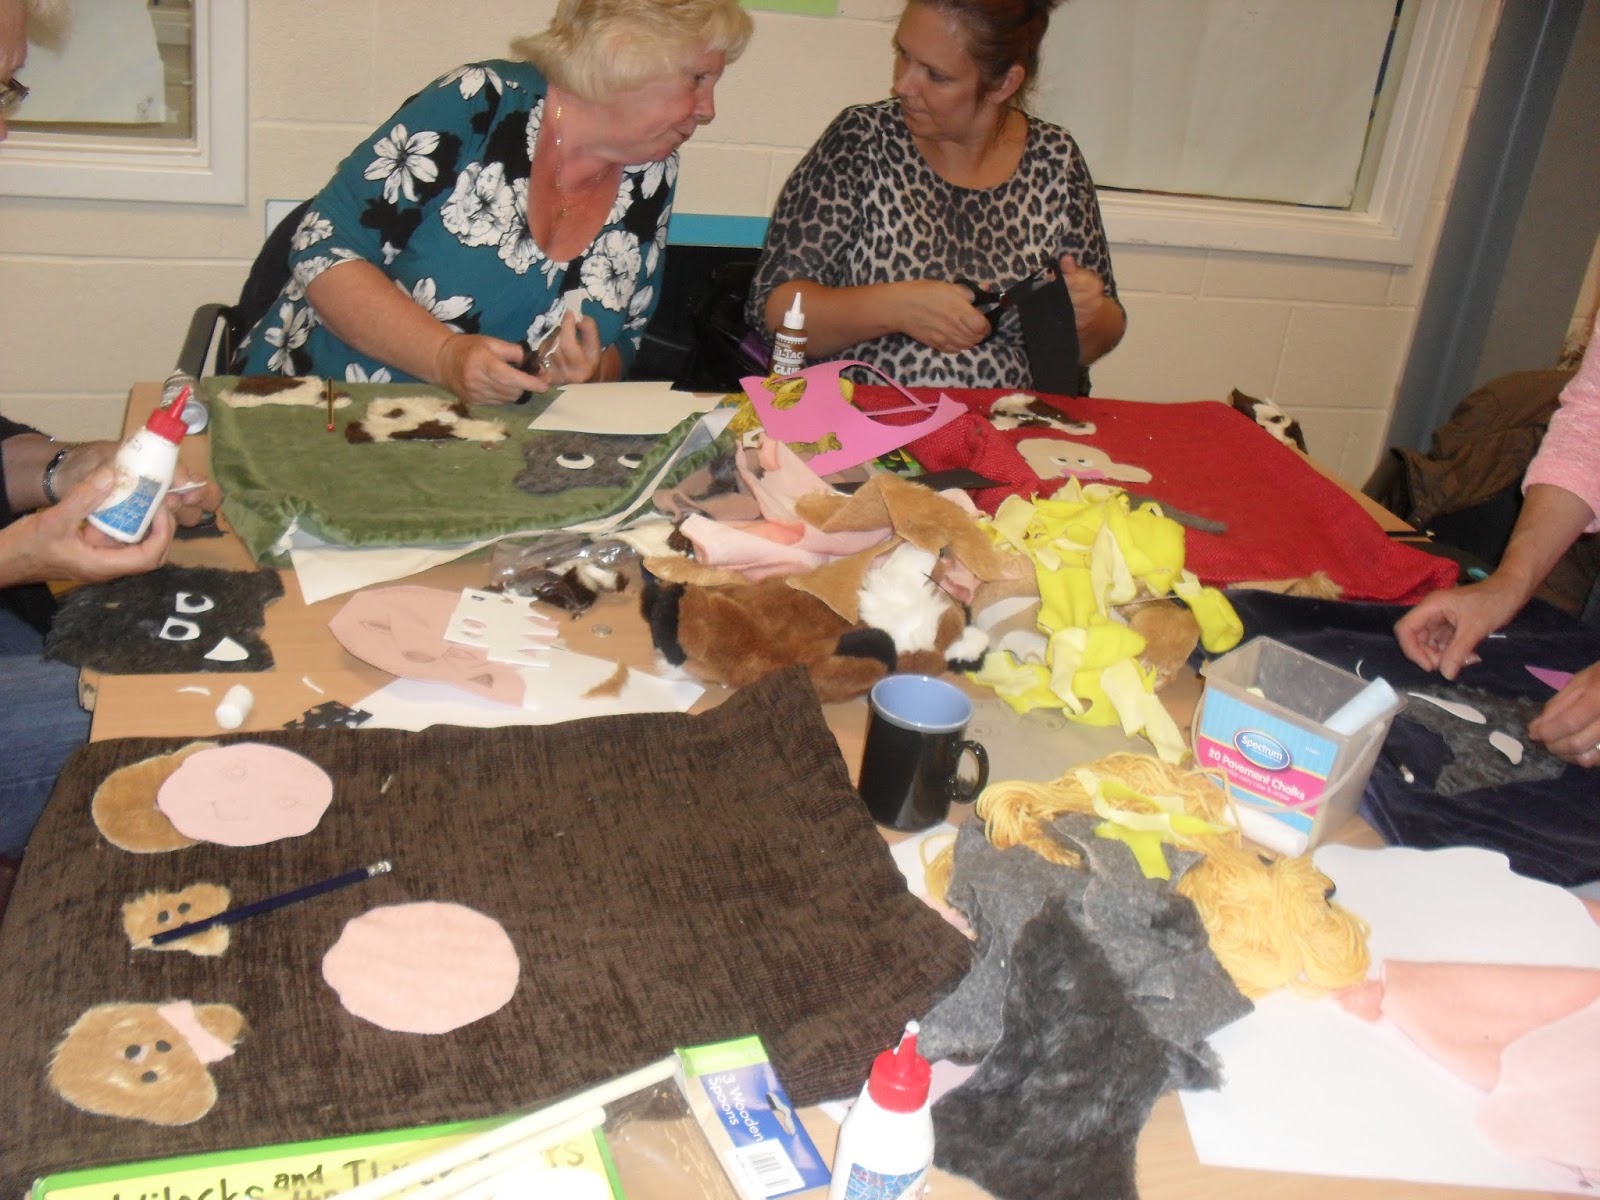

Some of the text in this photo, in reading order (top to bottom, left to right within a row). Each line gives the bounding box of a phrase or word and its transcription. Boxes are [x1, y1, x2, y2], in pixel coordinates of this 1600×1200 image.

[1241, 735, 1283, 761] Spectrum
[1208, 747, 1221, 761] 20
[1222, 754, 1271, 786] Pavement
[1271, 778, 1306, 801] Chalks
[709, 1077, 739, 1126] Spoons
[723, 1073, 736, 1085] 3
[730, 1087, 764, 1142] Wooden
[274, 1164, 324, 1191] and
